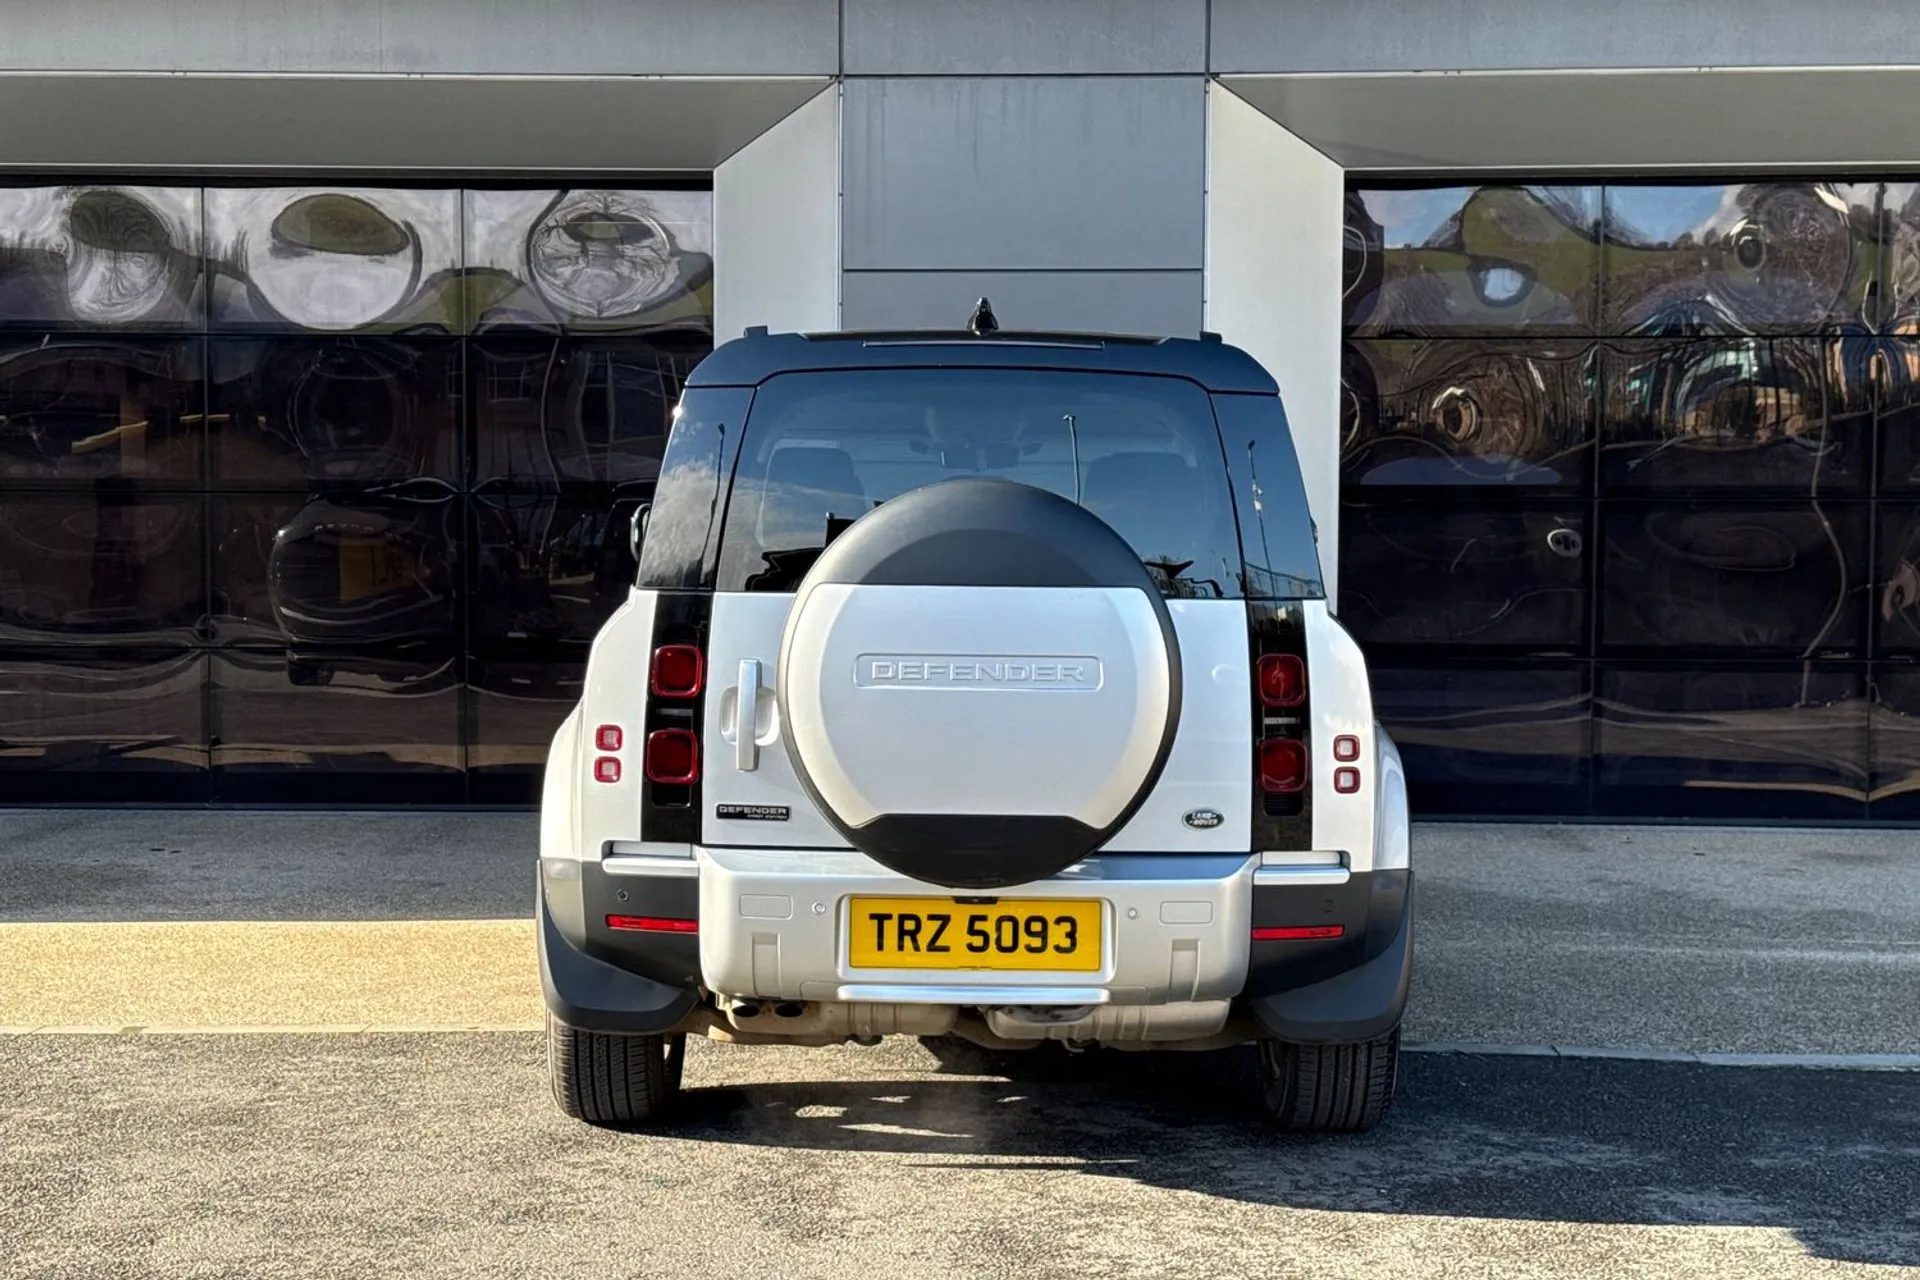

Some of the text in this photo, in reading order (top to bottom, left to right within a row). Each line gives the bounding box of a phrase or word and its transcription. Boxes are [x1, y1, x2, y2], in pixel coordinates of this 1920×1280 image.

[871, 661, 1084, 682] DEFENDER
[719, 806, 787, 815] DEFENDER
[868, 913, 1078, 955] TRZ 5093
